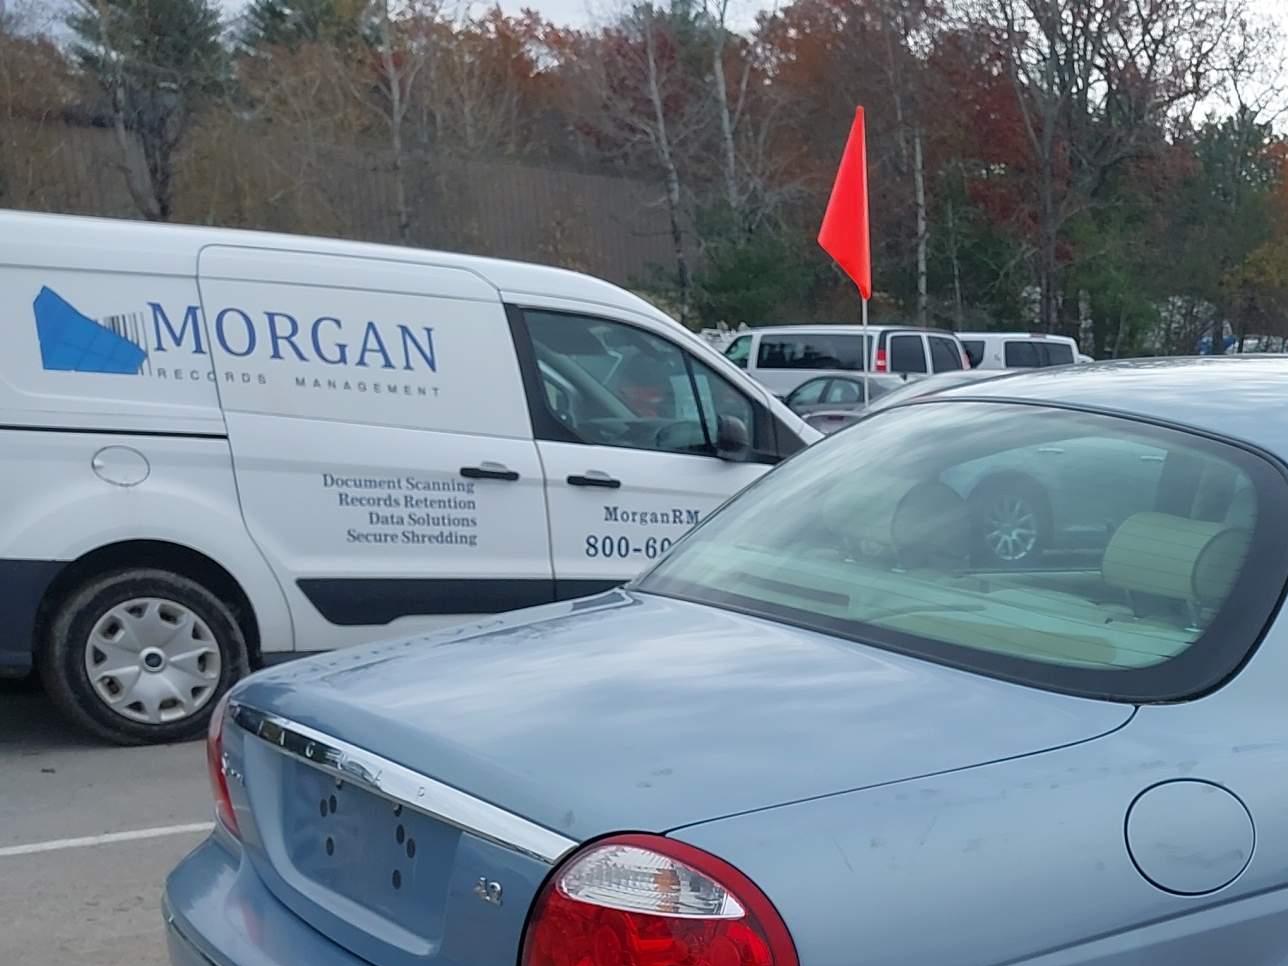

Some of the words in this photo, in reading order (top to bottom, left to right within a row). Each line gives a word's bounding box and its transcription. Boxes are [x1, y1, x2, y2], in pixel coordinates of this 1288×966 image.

[147, 302, 438, 373] MORGAN
[157, 367, 267, 385] RECORDS
[295, 376, 440, 397] MANAGEMENT
[323, 473, 401, 490] Document
[406, 477, 475, 494] Scanning
[338, 492, 400, 508] Records
[404, 495, 476, 510] Retention
[369, 511, 404, 526] Data
[408, 513, 477, 527] Solutions
[346, 529, 399, 543] Secure
[401, 530, 477, 546] Shredding
